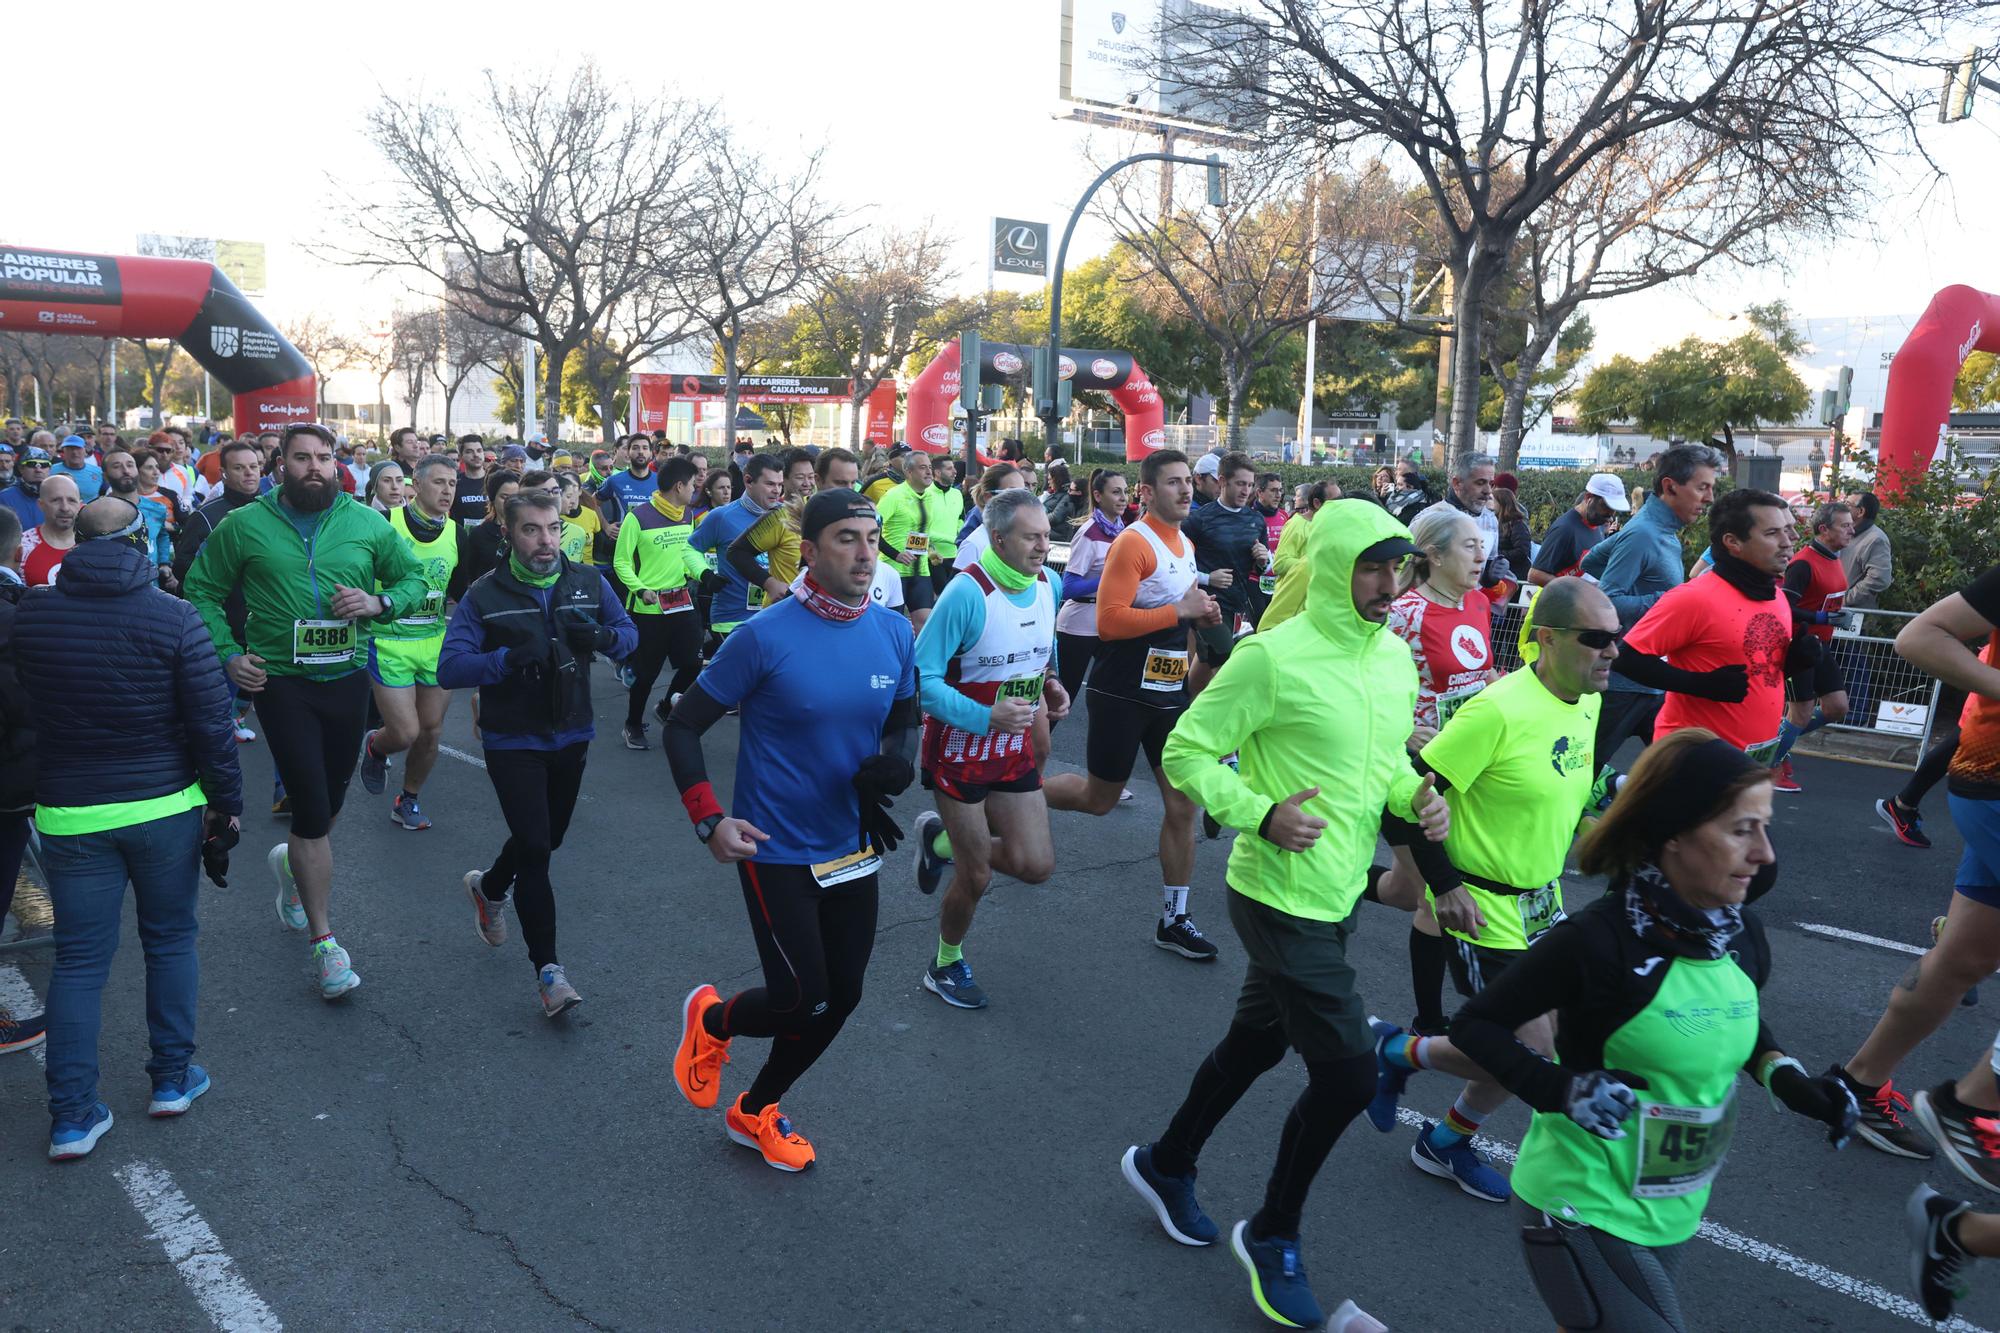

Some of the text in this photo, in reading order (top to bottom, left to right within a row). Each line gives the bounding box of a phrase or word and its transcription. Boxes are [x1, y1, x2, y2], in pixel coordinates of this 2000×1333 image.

[0, 252, 99, 272] ARRERES
[999, 256, 1044, 269] LEXUS
[1881, 352, 1895, 361] SE
[750, 378, 760, 386] DE
[761, 378, 800, 387] CARRERES
[303, 628, 349, 646] 4388
[1151, 657, 1184, 677] 3528
[1658, 1123, 1710, 1163] 45
